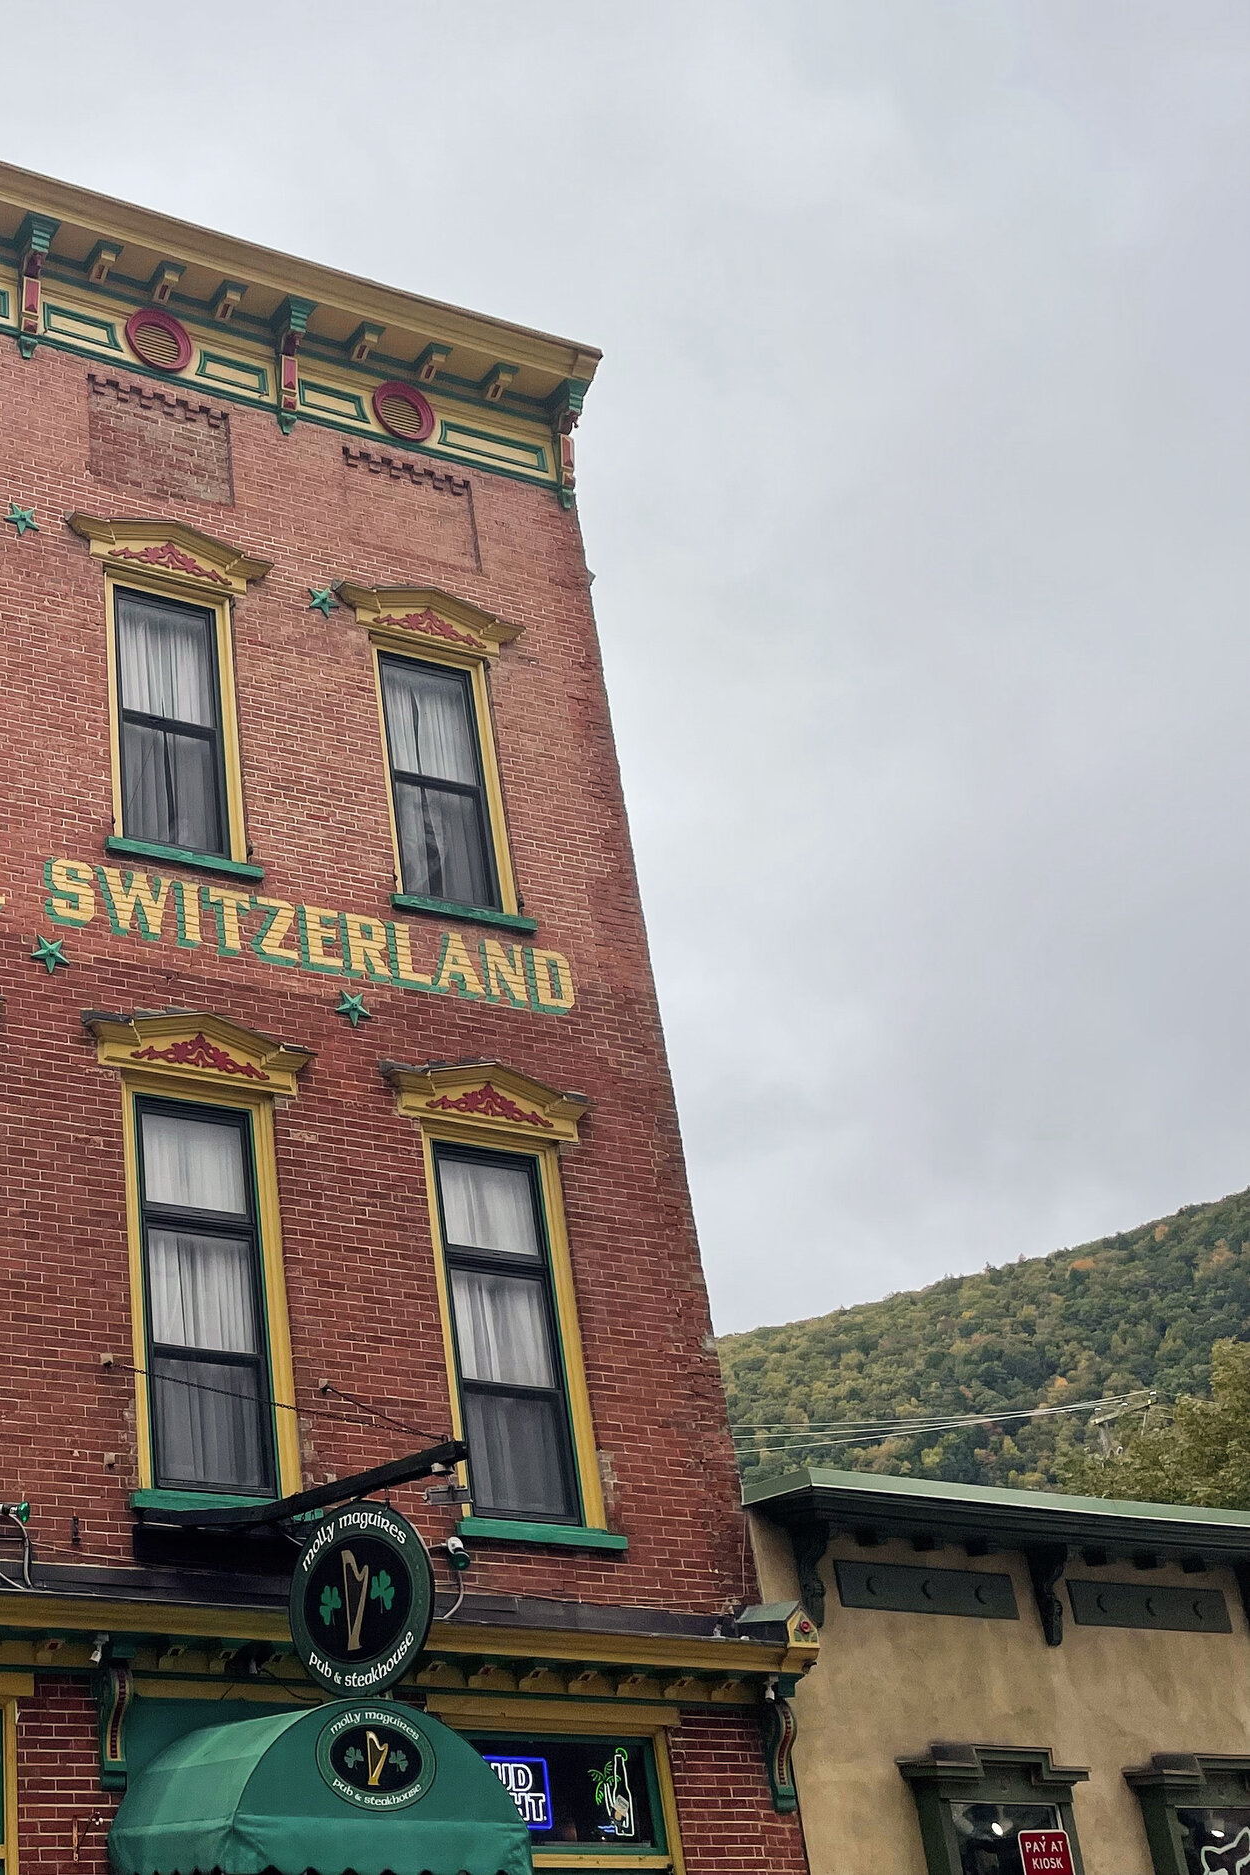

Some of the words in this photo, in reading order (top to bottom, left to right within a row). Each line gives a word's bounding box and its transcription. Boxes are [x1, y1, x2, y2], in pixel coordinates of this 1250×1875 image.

[43, 856, 576, 1016] SWITZERLAND
[301, 1521, 335, 1572] molly
[309, 1651, 332, 1678] pub
[333, 1671, 342, 1685] &
[344, 1631, 414, 1688] steakhouse
[330, 1712, 361, 1735] molly
[490, 1762, 533, 1792] UD
[332, 1778, 354, 1796] pub
[354, 1793, 362, 1801] &
[363, 1783, 422, 1806] steakhouse
[1025, 1841, 1047, 1853] PAY
[1051, 1840, 1063, 1852] AT
[1032, 1857, 1063, 1869] KIOSK
